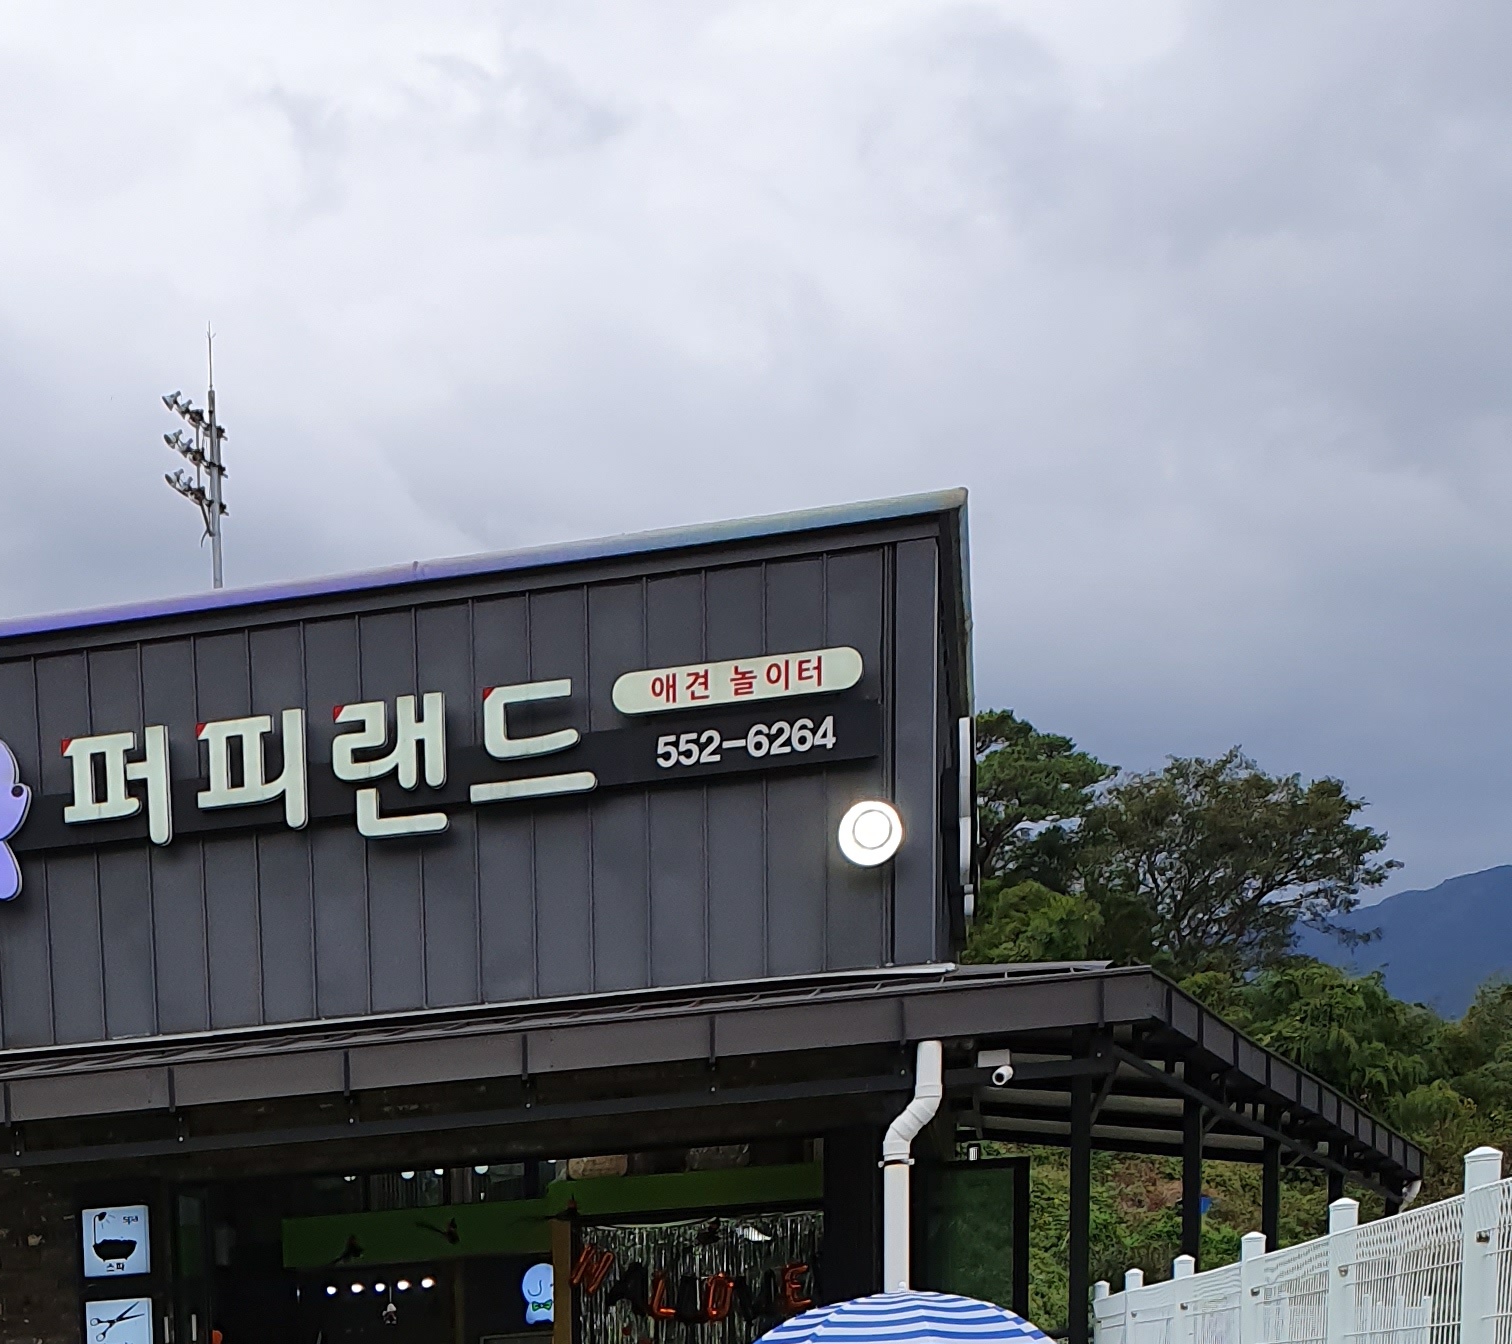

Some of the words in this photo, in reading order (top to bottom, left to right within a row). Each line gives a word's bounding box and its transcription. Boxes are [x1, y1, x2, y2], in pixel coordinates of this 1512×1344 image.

[650, 668, 711, 704] 애견
[729, 655, 823, 697] 놀이터
[60, 678, 598, 847] 퍼피랜드
[656, 715, 837, 768] 552-6264
[122, 1215, 139, 1225] spa
[106, 1262, 125, 1272] 스파
